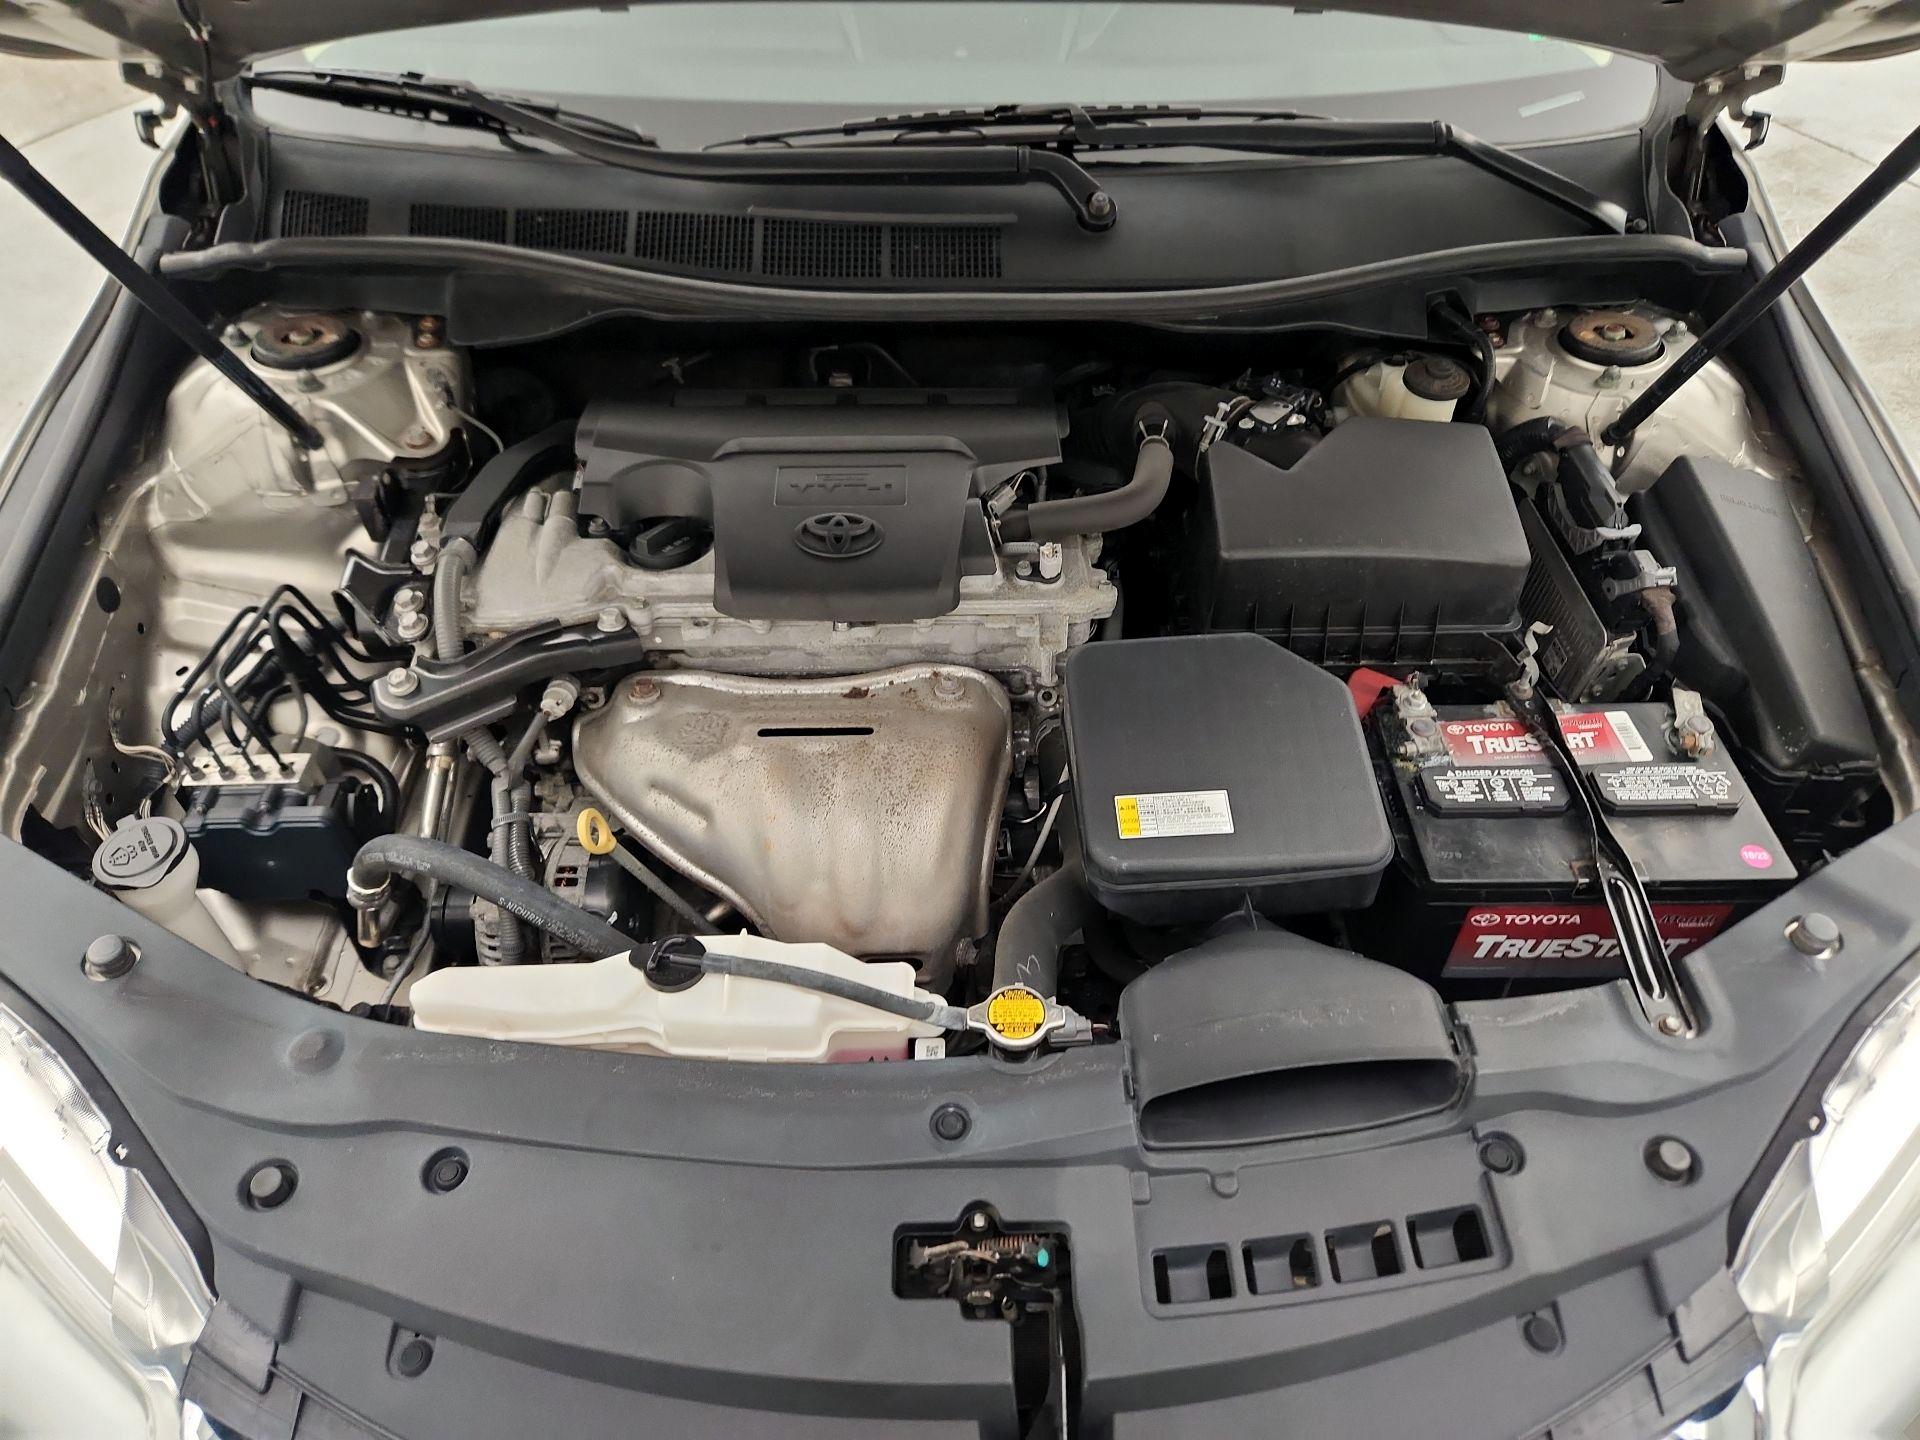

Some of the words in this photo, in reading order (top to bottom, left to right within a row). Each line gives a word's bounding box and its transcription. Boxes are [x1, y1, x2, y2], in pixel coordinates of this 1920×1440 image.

[1464, 723, 1514, 733] TOYOTA
[1465, 731, 1597, 755] TRUESRT
[1455, 769, 1492, 778] DANGER
[1500, 768, 1534, 777] POISON
[1504, 914, 1581, 925] TOYOTA
